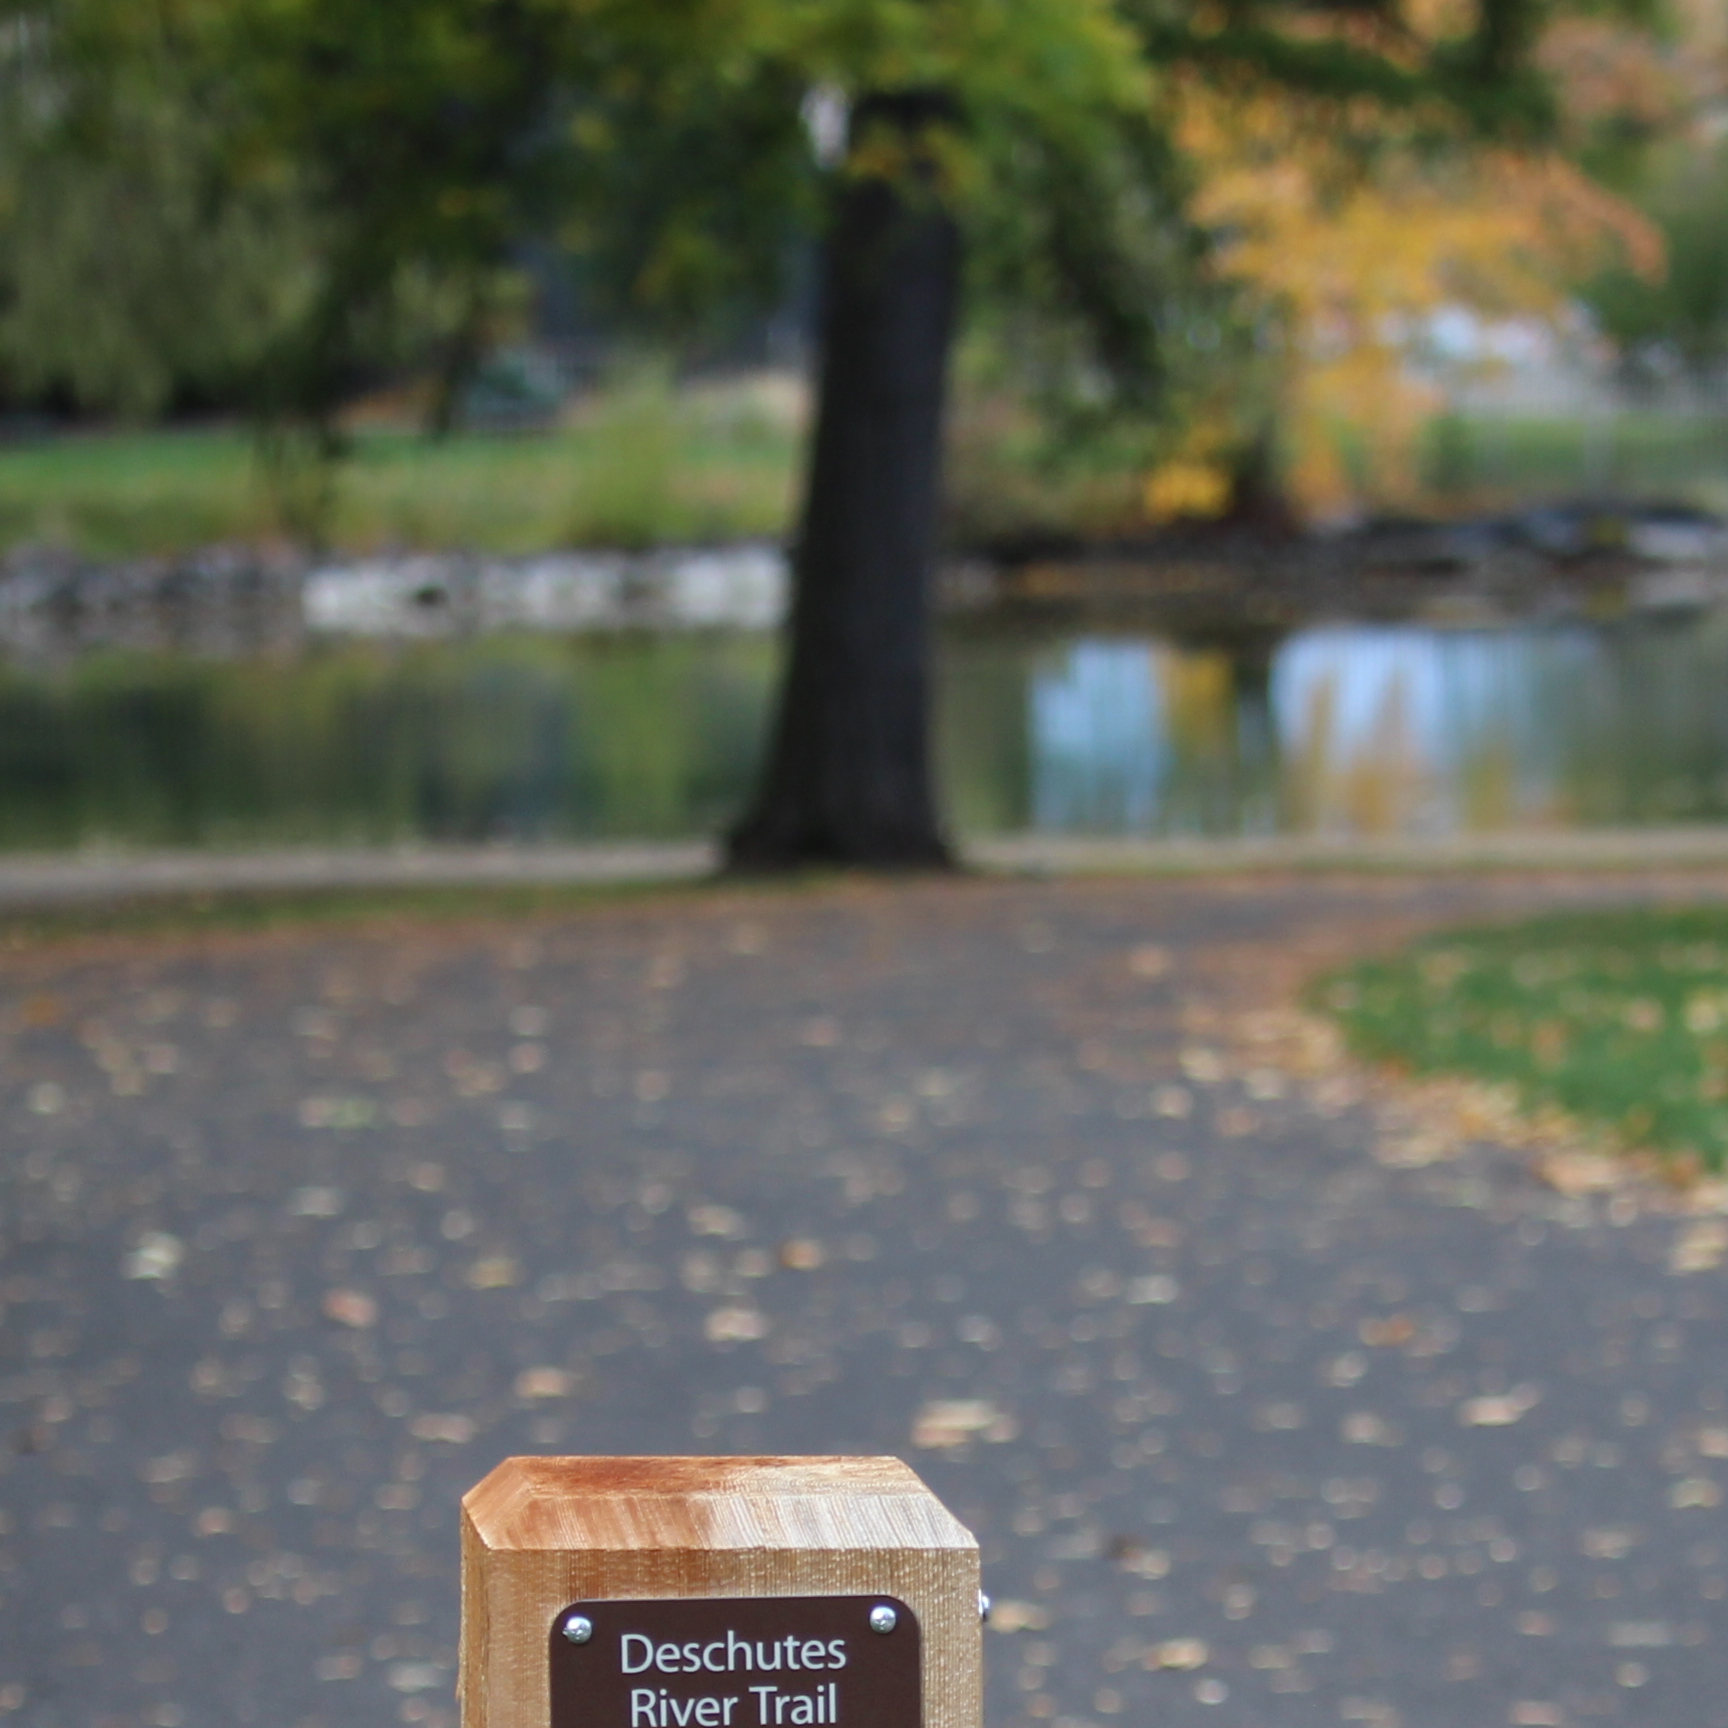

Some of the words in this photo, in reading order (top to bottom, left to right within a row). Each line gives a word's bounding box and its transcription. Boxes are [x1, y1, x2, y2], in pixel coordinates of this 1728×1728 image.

[620, 1630, 847, 1674] Deschutes
[630, 1688, 739, 1728] River
[748, 1683, 838, 1726] Trail
